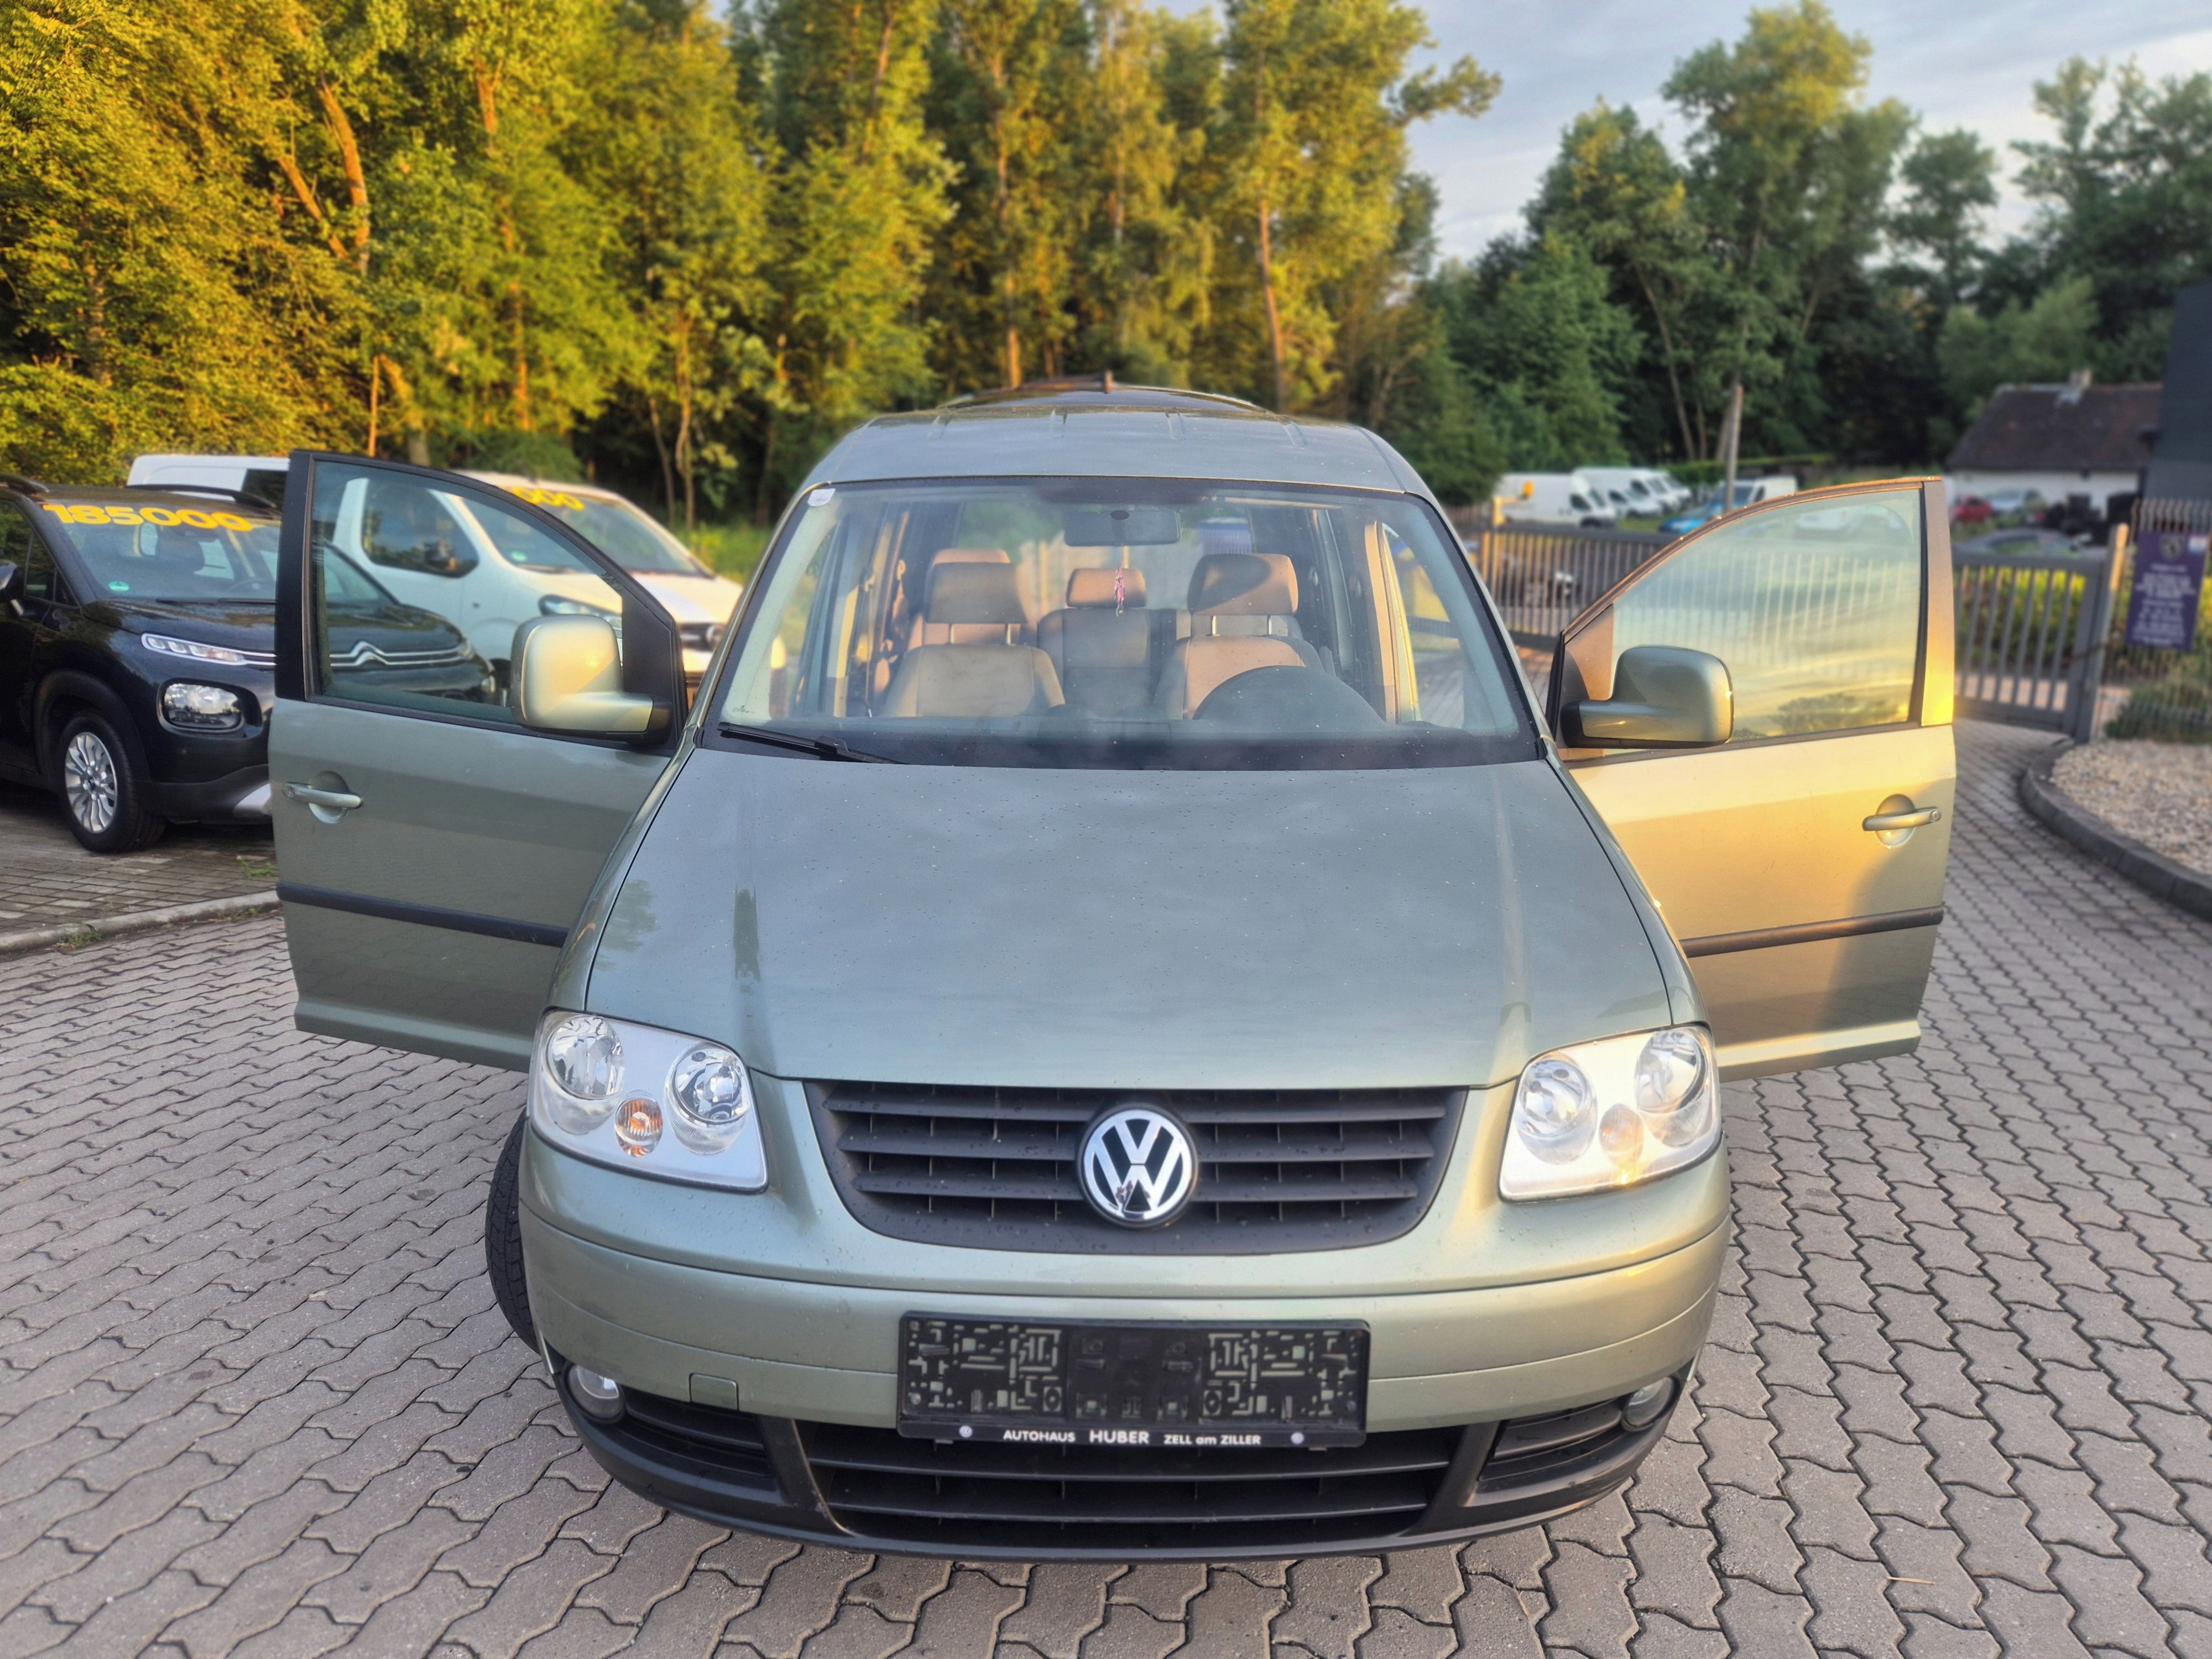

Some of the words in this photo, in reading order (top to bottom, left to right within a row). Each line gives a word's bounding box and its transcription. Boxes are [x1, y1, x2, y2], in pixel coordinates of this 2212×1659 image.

[43, 504, 253, 531] 185000
[1084, 1109, 1192, 1219] VW
[1003, 1430, 1076, 1442] AUTOHAUS
[1089, 1430, 1150, 1444] HUBER
[1164, 1434, 1192, 1445] ZELL
[1196, 1436, 1217, 1445] am
[1220, 1435, 1261, 1445] ZILLER
